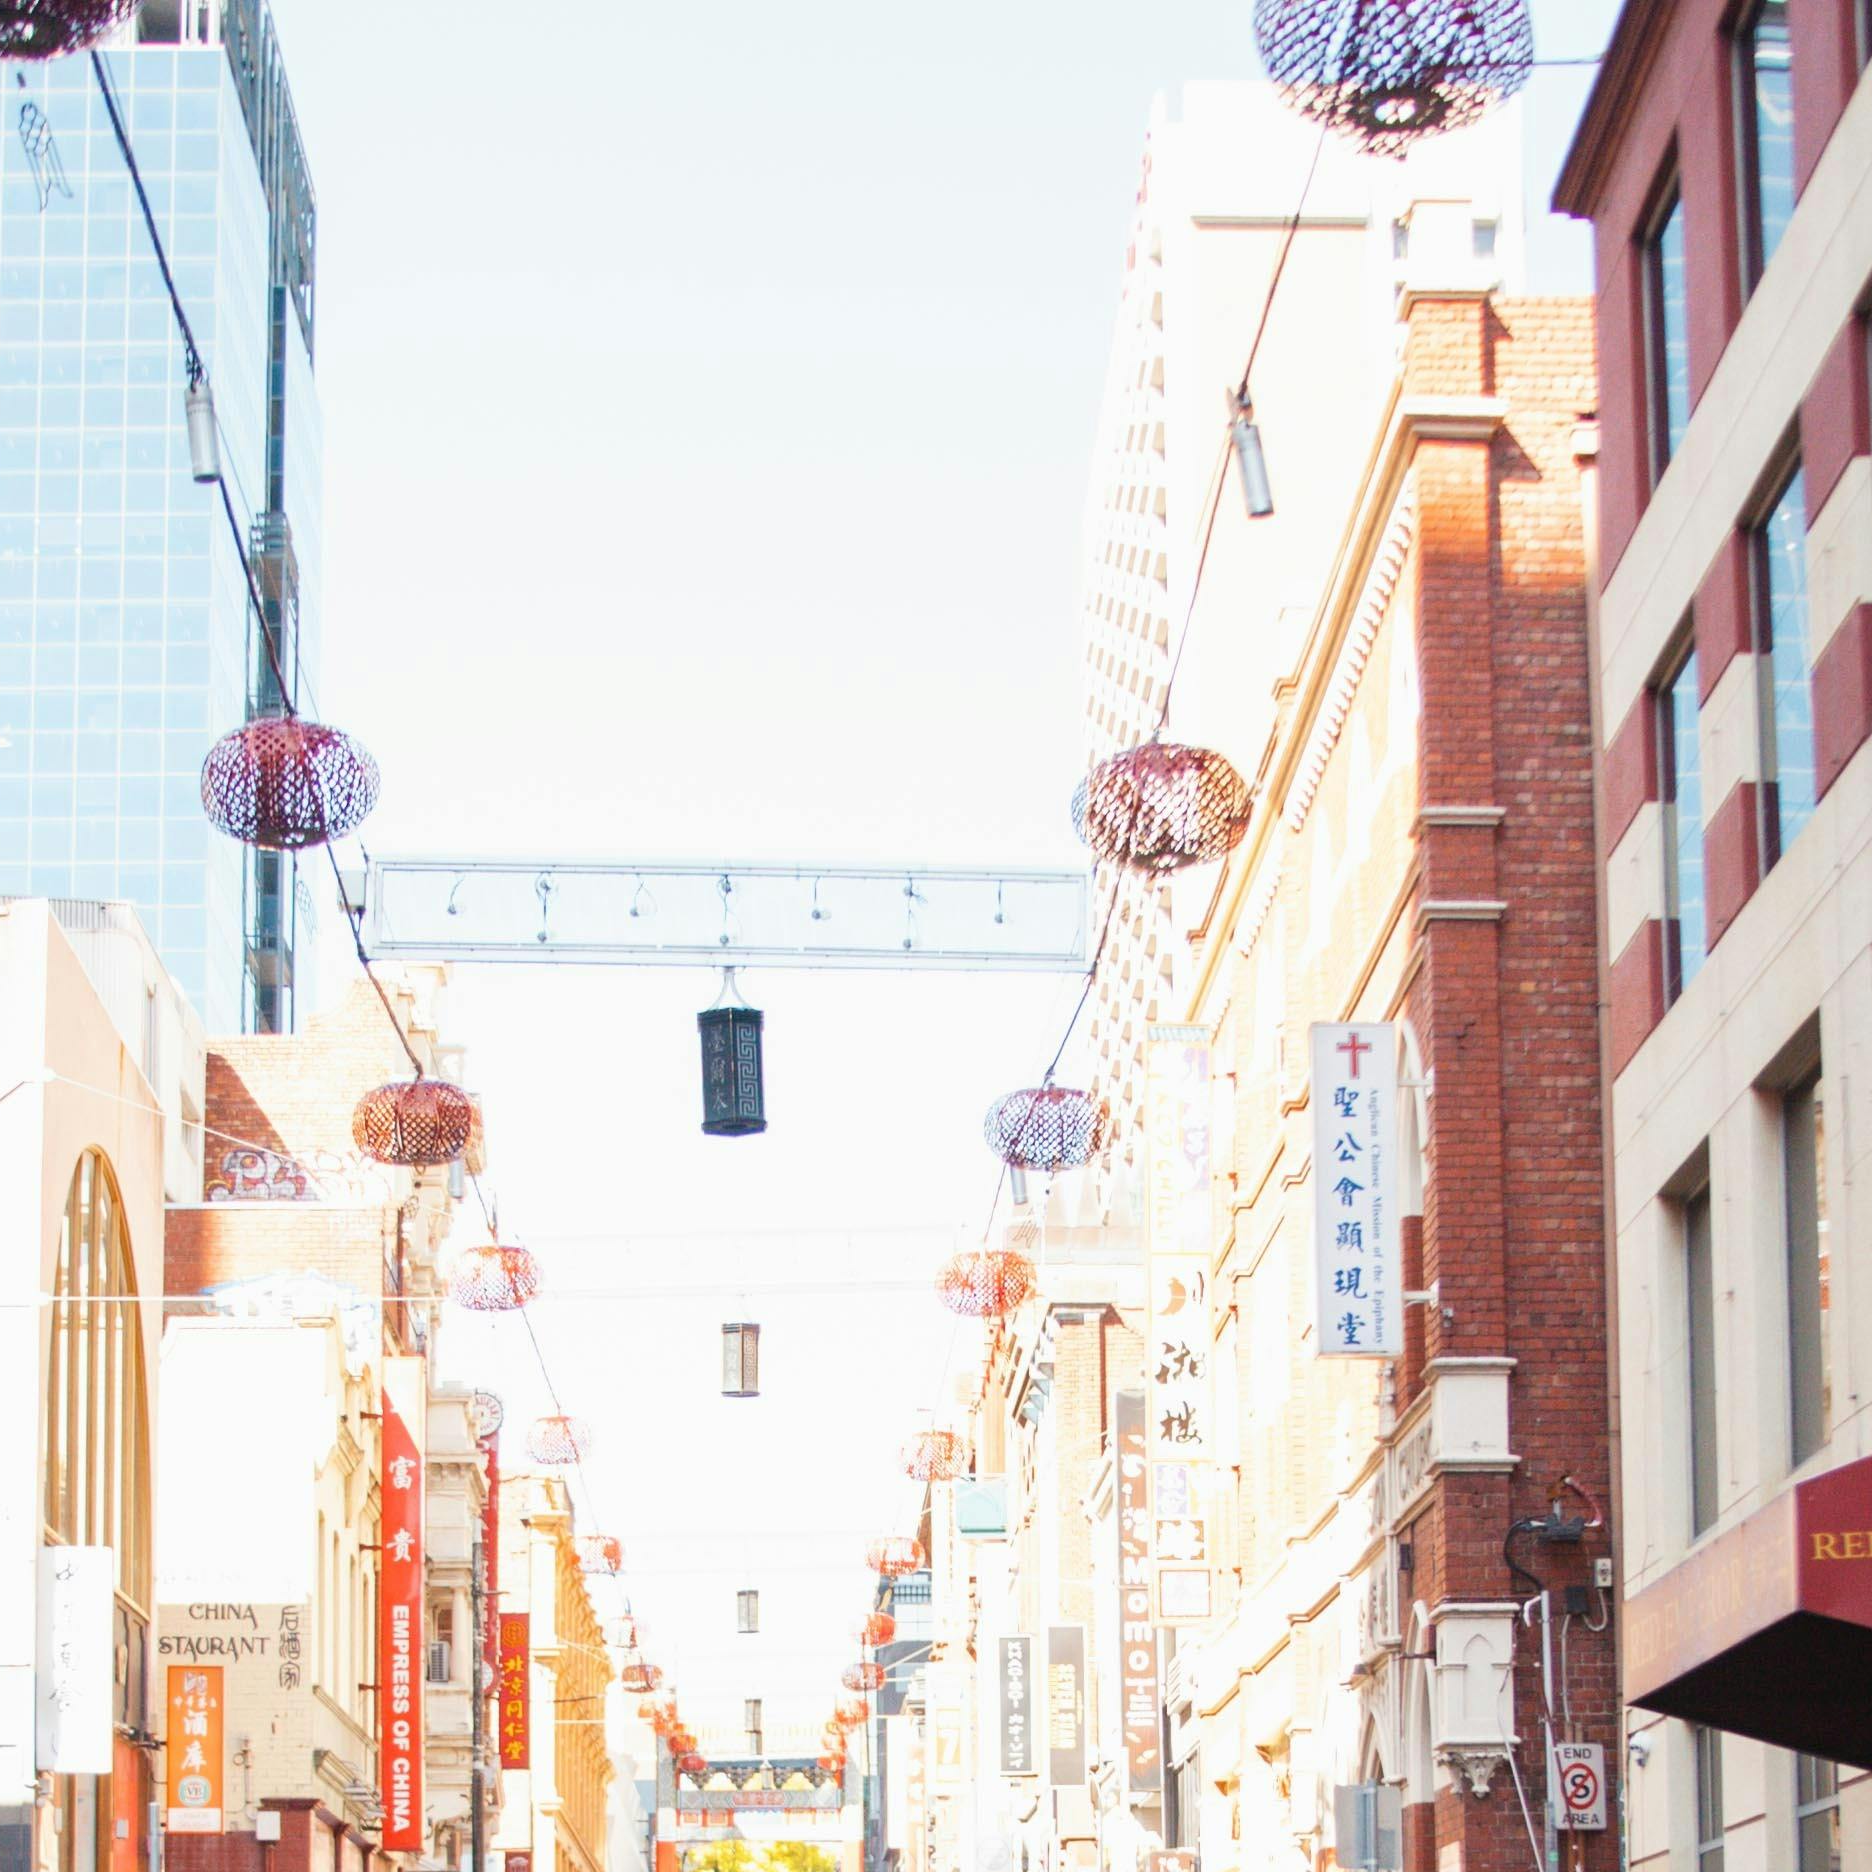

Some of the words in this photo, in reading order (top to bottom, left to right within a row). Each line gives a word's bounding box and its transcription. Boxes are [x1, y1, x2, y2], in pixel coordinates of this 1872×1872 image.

[1368, 1088, 1379, 1137] Anglican
[1371, 1144, 1381, 1189] Chinese
[1373, 1196, 1382, 1240] Mission
[1374, 1247, 1383, 1259] of
[1373, 1264, 1383, 1282] the
[1374, 1290, 1385, 1344] Epiphany
[189, 1603, 259, 1629] CHINA
[392, 1605, 410, 1714] EMPRESS
[392, 1720, 410, 1751] OF
[1564, 1748, 1592, 1759] END
[393, 1756, 411, 1833] CHINA
[1562, 1813, 1599, 1825] AREA
